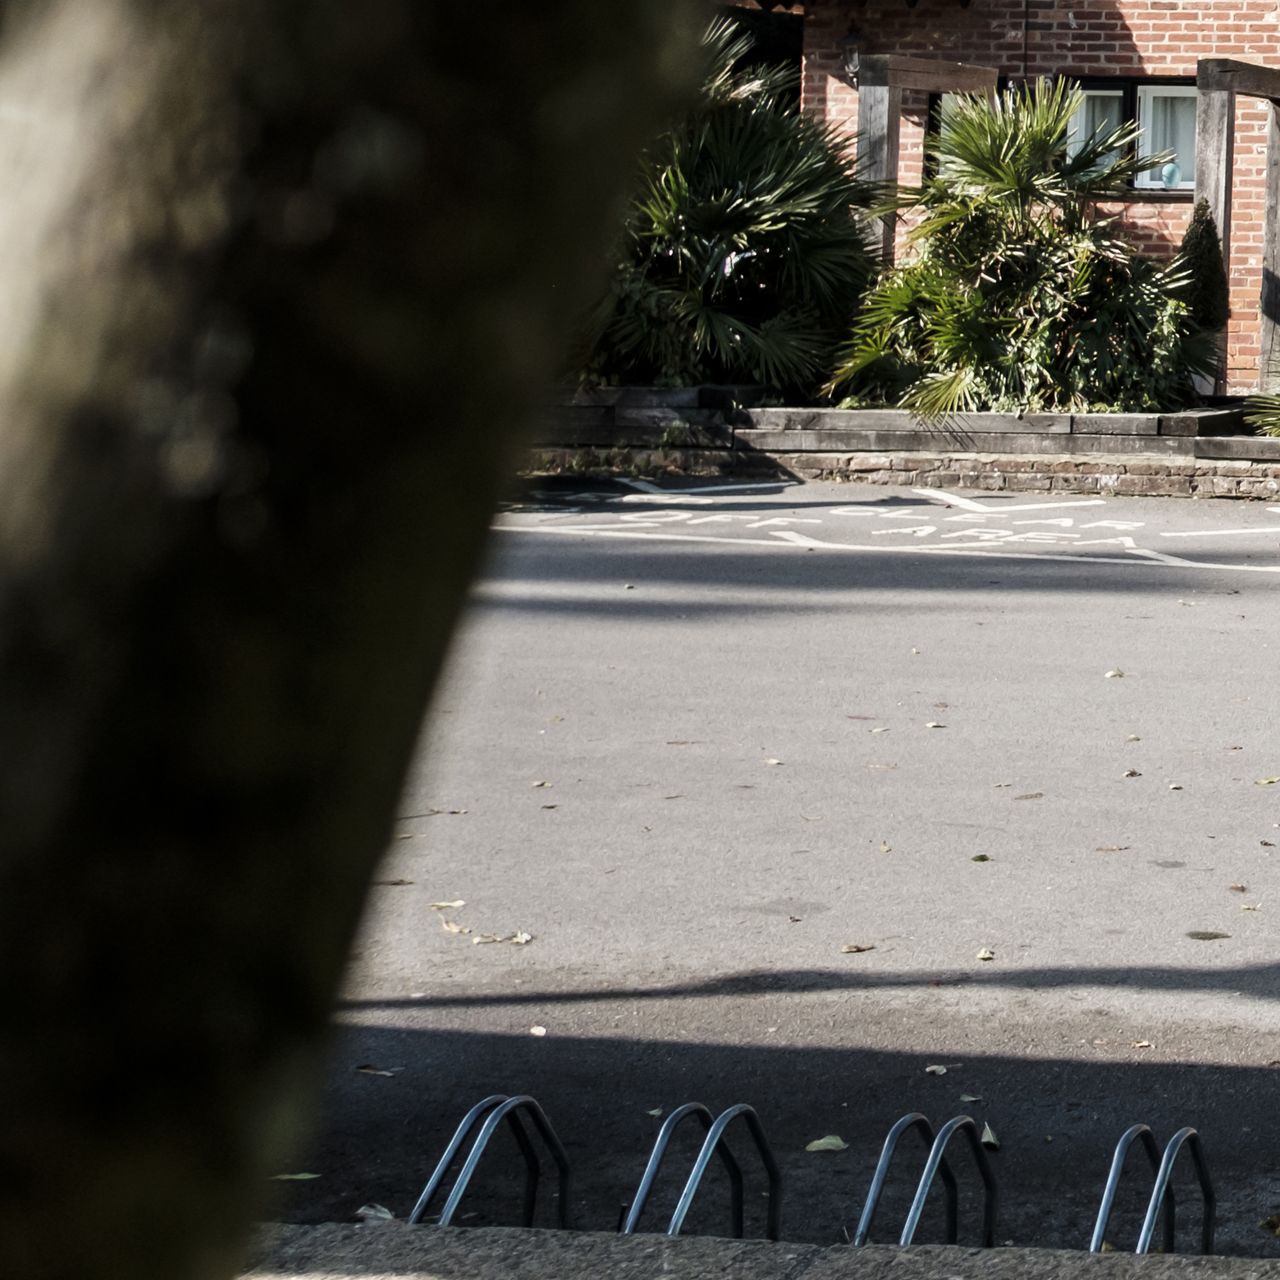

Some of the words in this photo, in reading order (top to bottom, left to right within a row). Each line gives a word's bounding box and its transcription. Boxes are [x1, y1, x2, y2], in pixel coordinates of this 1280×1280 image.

[619, 510, 823, 528] OFF
[871, 525, 1137, 548] AREA
[829, 506, 1146, 531] CLEAR
